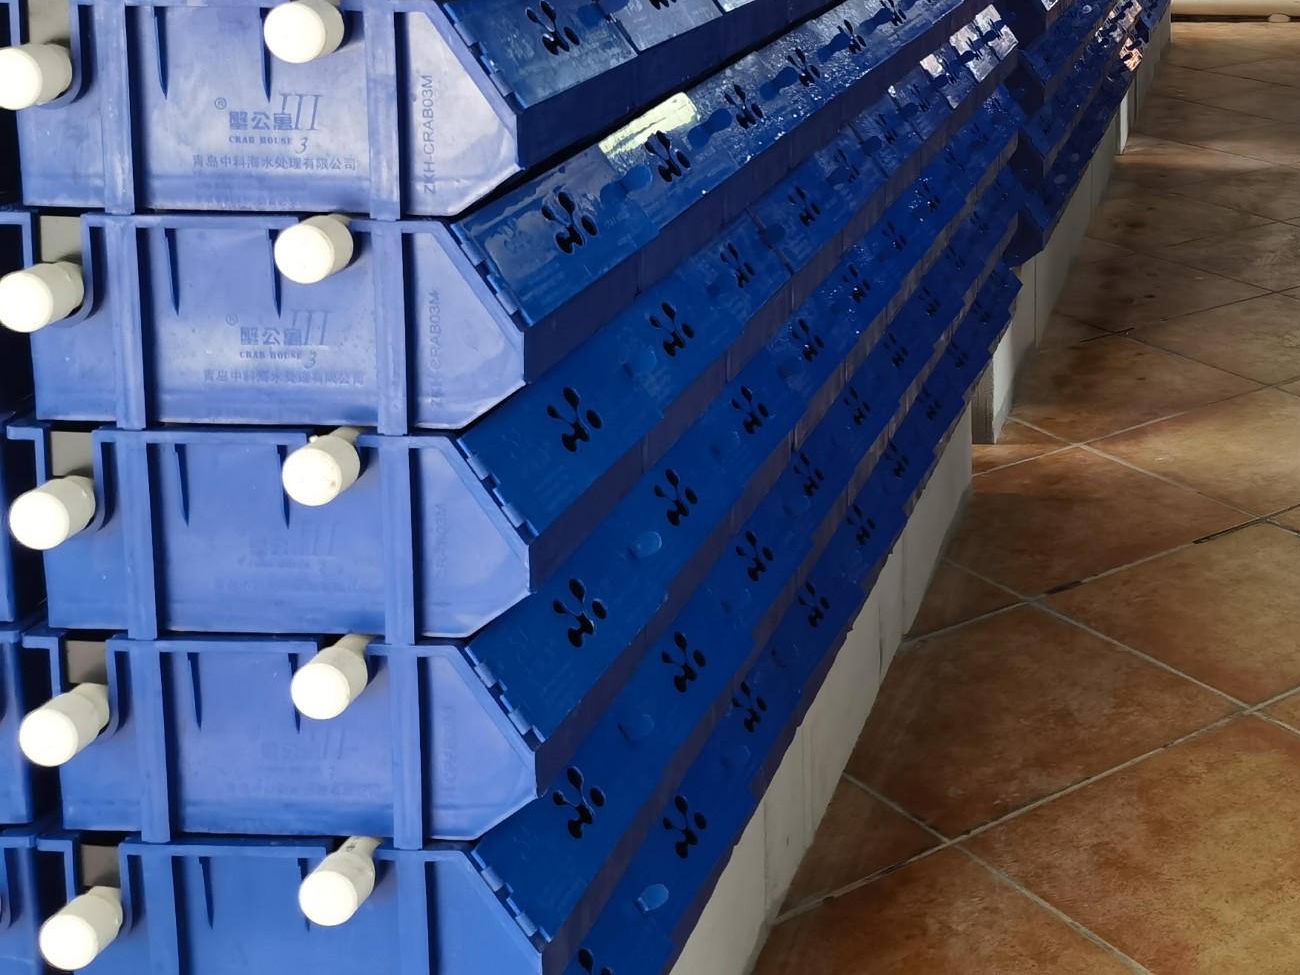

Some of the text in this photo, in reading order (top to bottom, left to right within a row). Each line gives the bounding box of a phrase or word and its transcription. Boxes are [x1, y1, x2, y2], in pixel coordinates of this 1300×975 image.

[229, 136, 292, 145] CRAB HOUSE
[421, 75, 436, 195] ZKH-CRAB03M
[295, 137, 309, 154] 3
[192, 154, 357, 171] 青岛中科海水处理有限公司
[239, 350, 302, 360] CRAB HOUSE
